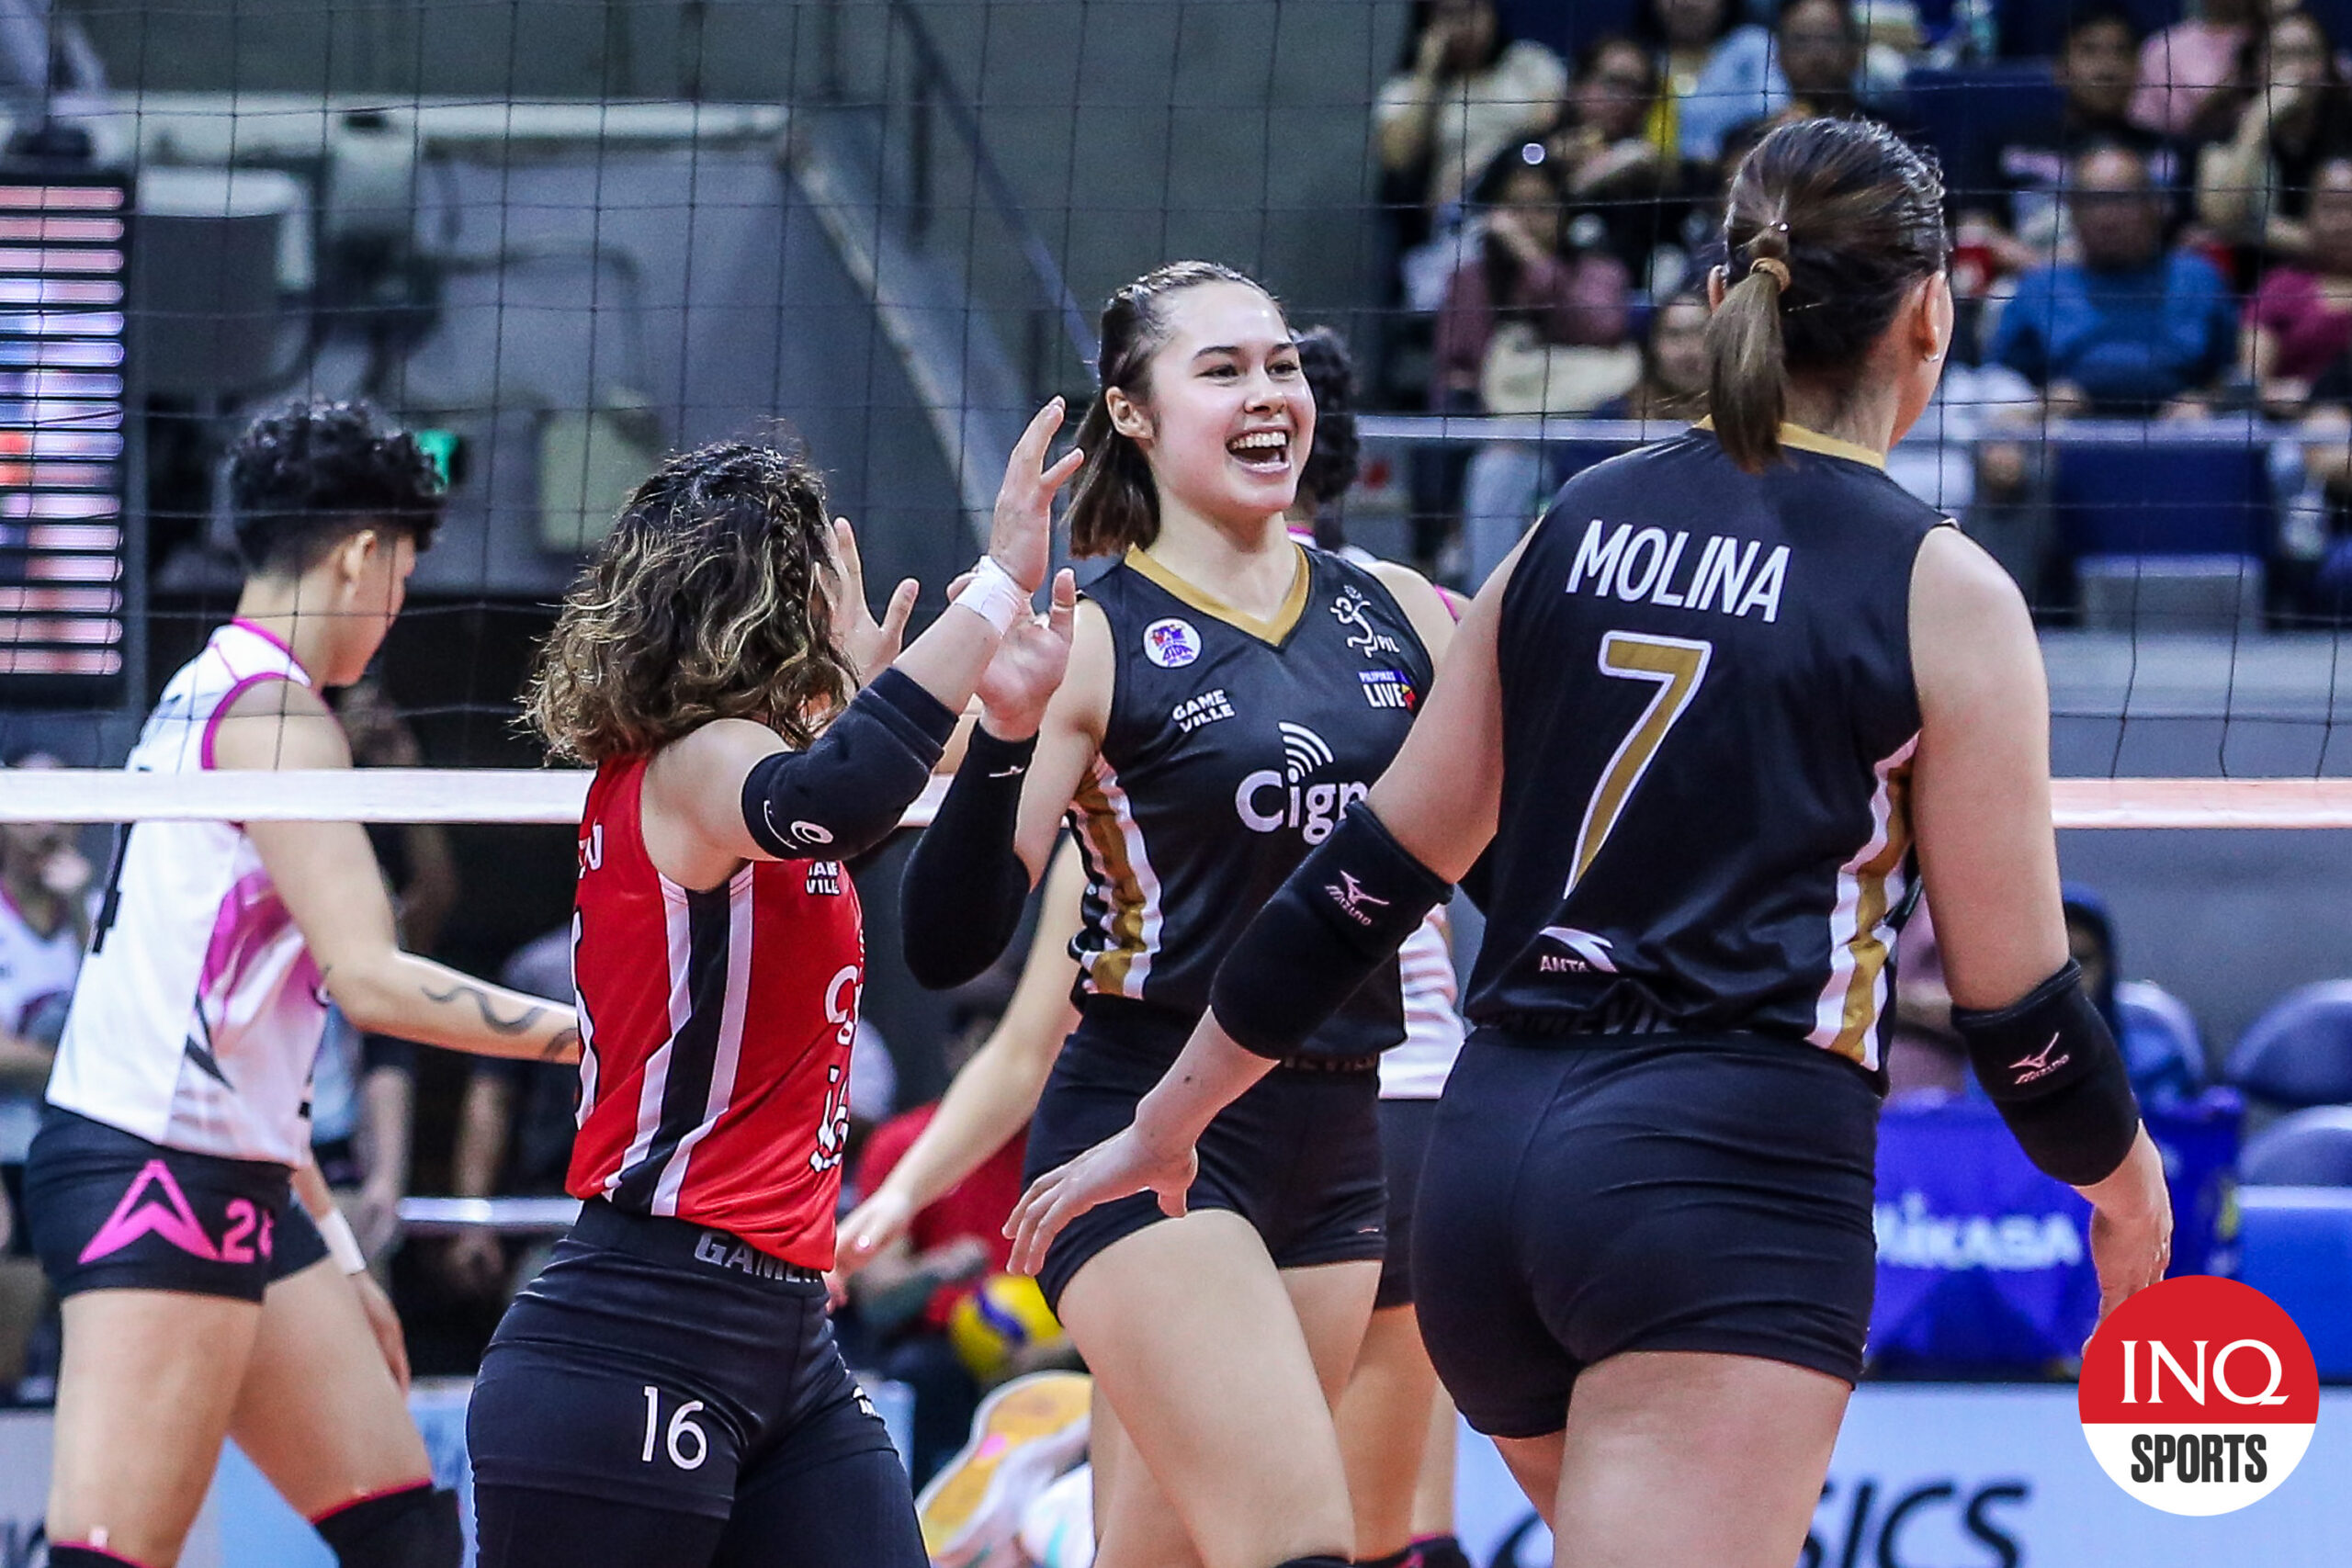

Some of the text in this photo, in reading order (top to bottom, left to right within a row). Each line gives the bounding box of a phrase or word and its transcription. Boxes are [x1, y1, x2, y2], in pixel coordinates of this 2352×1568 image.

[1566, 519, 1791, 623] MOLINA
[1172, 689, 1227, 721] GAME
[1363, 682, 1406, 707] LIVE
[1179, 704, 1236, 733] VILLE
[1563, 630, 1713, 899] 7
[1540, 955, 1590, 973] ANTA
[642, 1385, 707, 1471] 16
